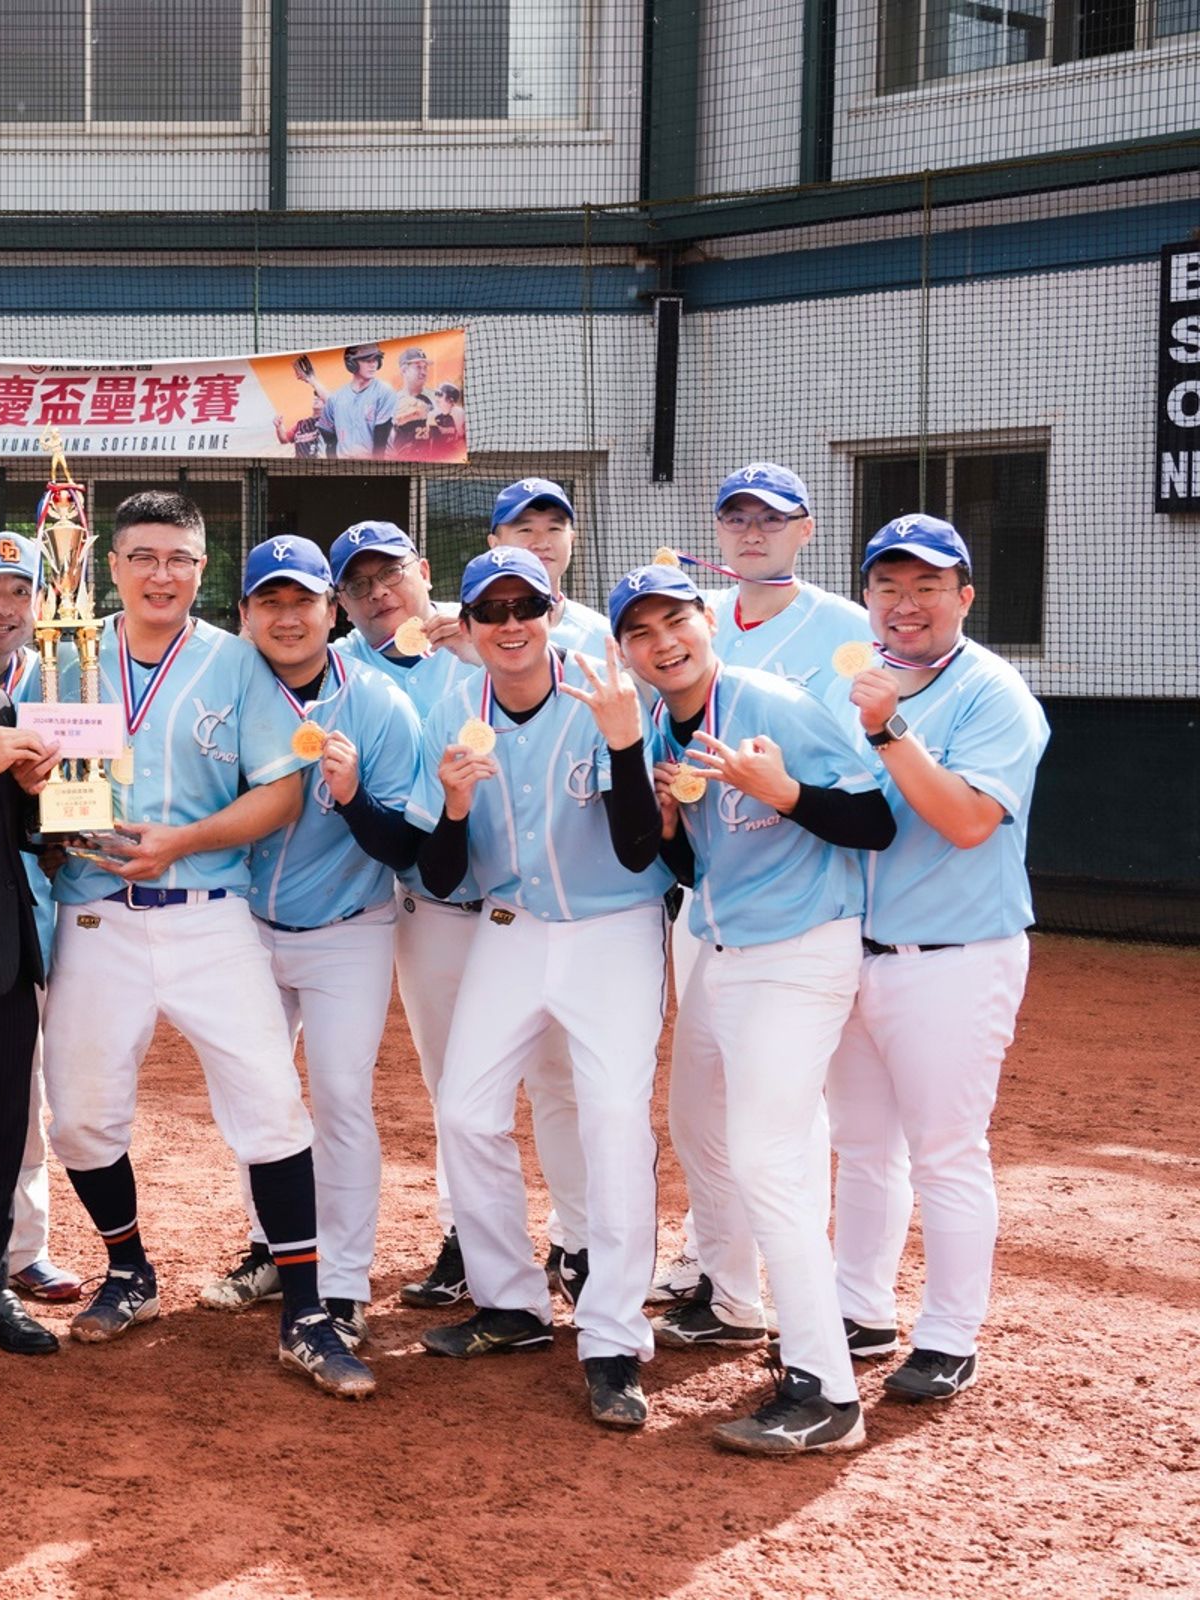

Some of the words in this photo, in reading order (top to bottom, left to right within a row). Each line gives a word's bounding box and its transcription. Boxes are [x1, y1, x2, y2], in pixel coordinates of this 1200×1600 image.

[2, 437, 92, 451] YUNGING
[101, 436, 177, 451] SOFTBALL
[188, 434, 229, 450] GAME
